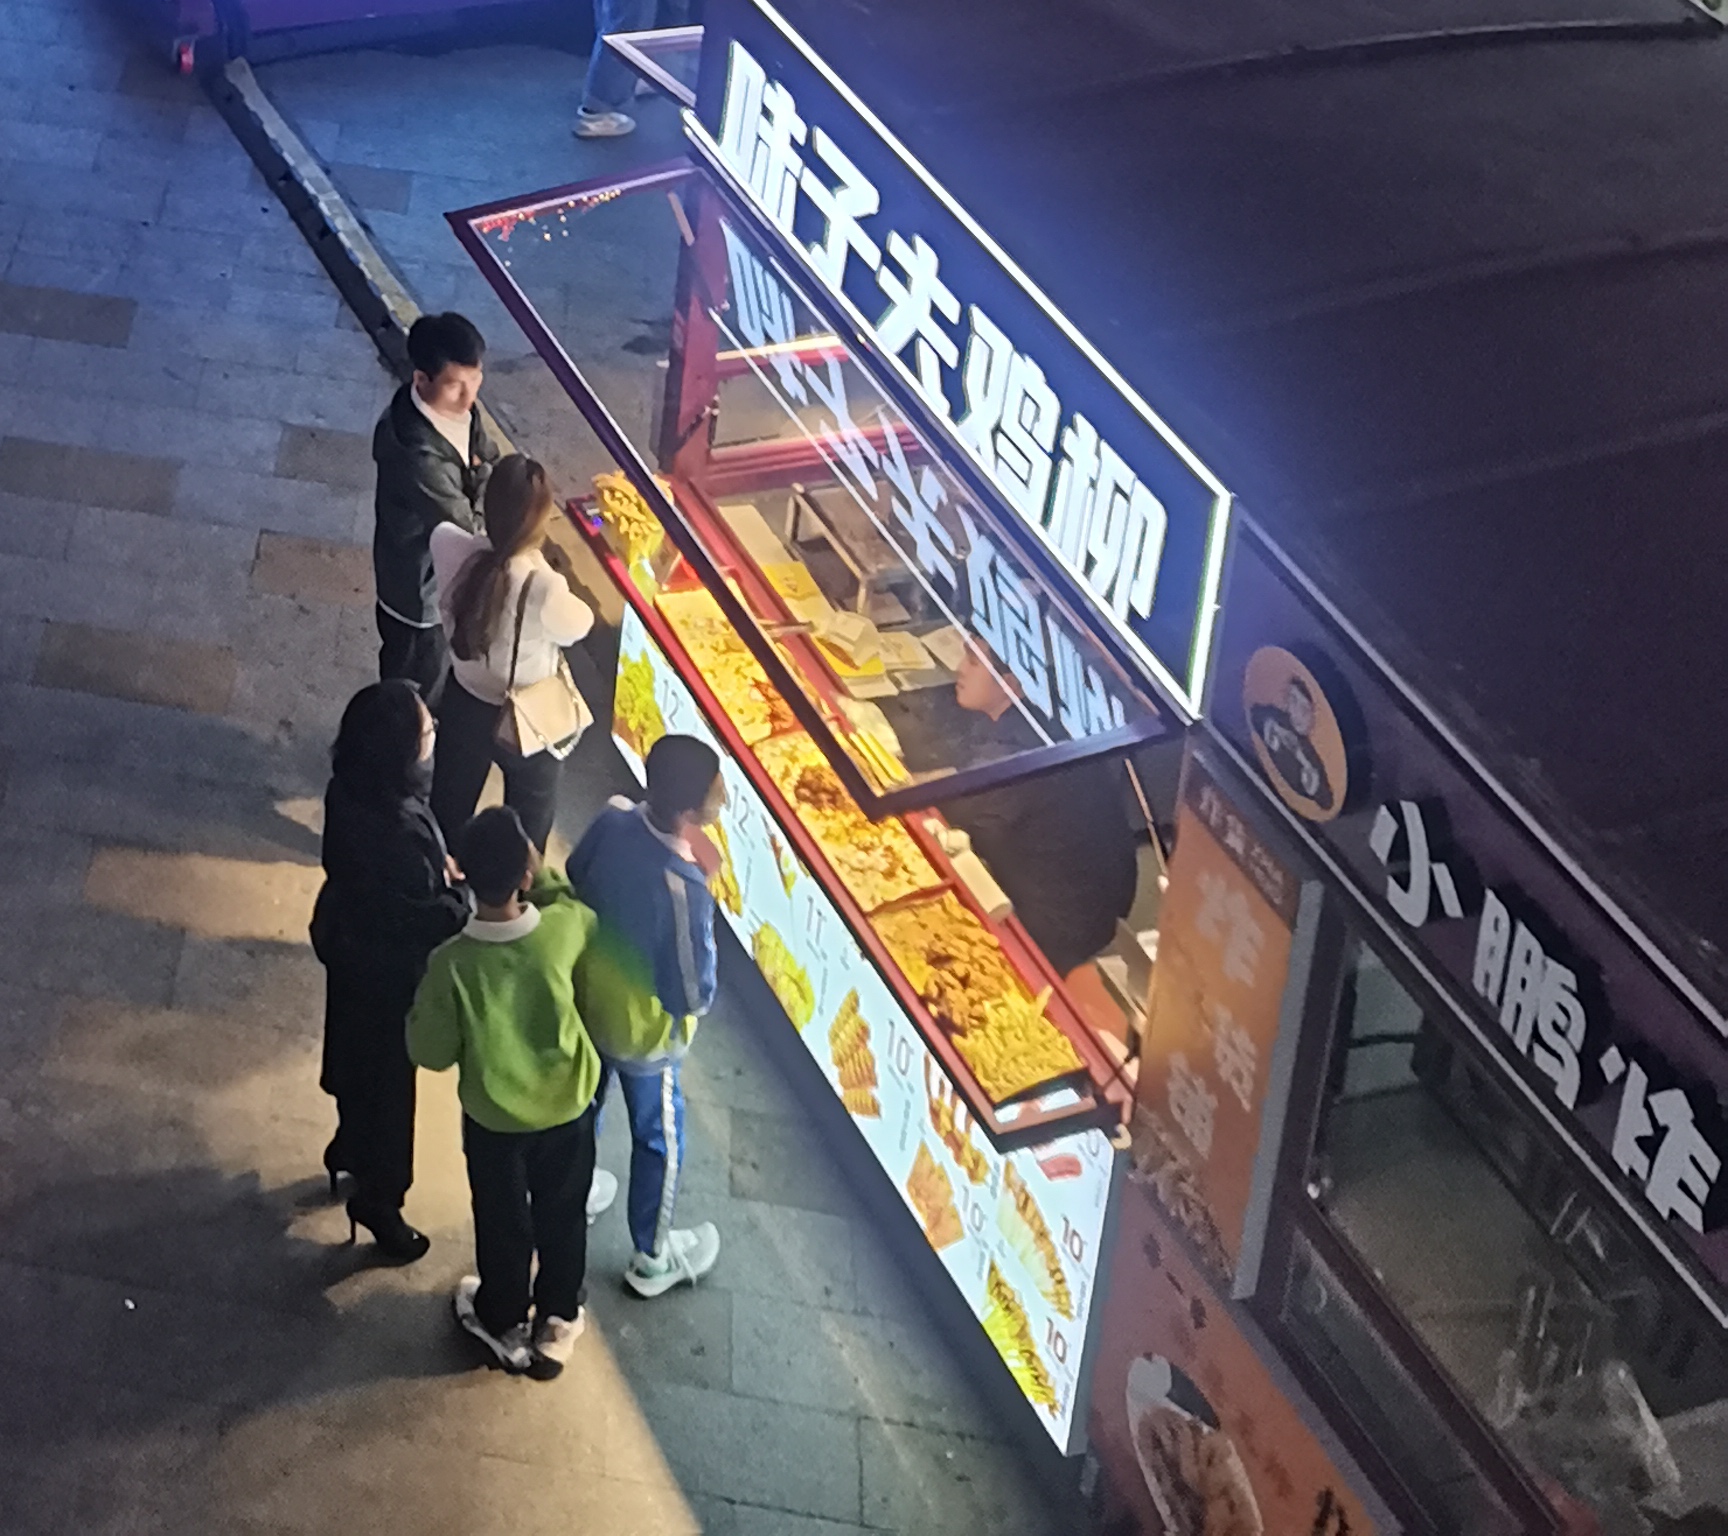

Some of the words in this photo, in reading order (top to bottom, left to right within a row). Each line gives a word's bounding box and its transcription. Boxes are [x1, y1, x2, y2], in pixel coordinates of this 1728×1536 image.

[718, 39, 1168, 622] 味子夫鸡柳
[1368, 799, 1722, 1235] 小鹏炸
[886, 1019, 911, 1077] 10
[1061, 1214, 1084, 1263] 10
[1044, 1316, 1068, 1364] 10
